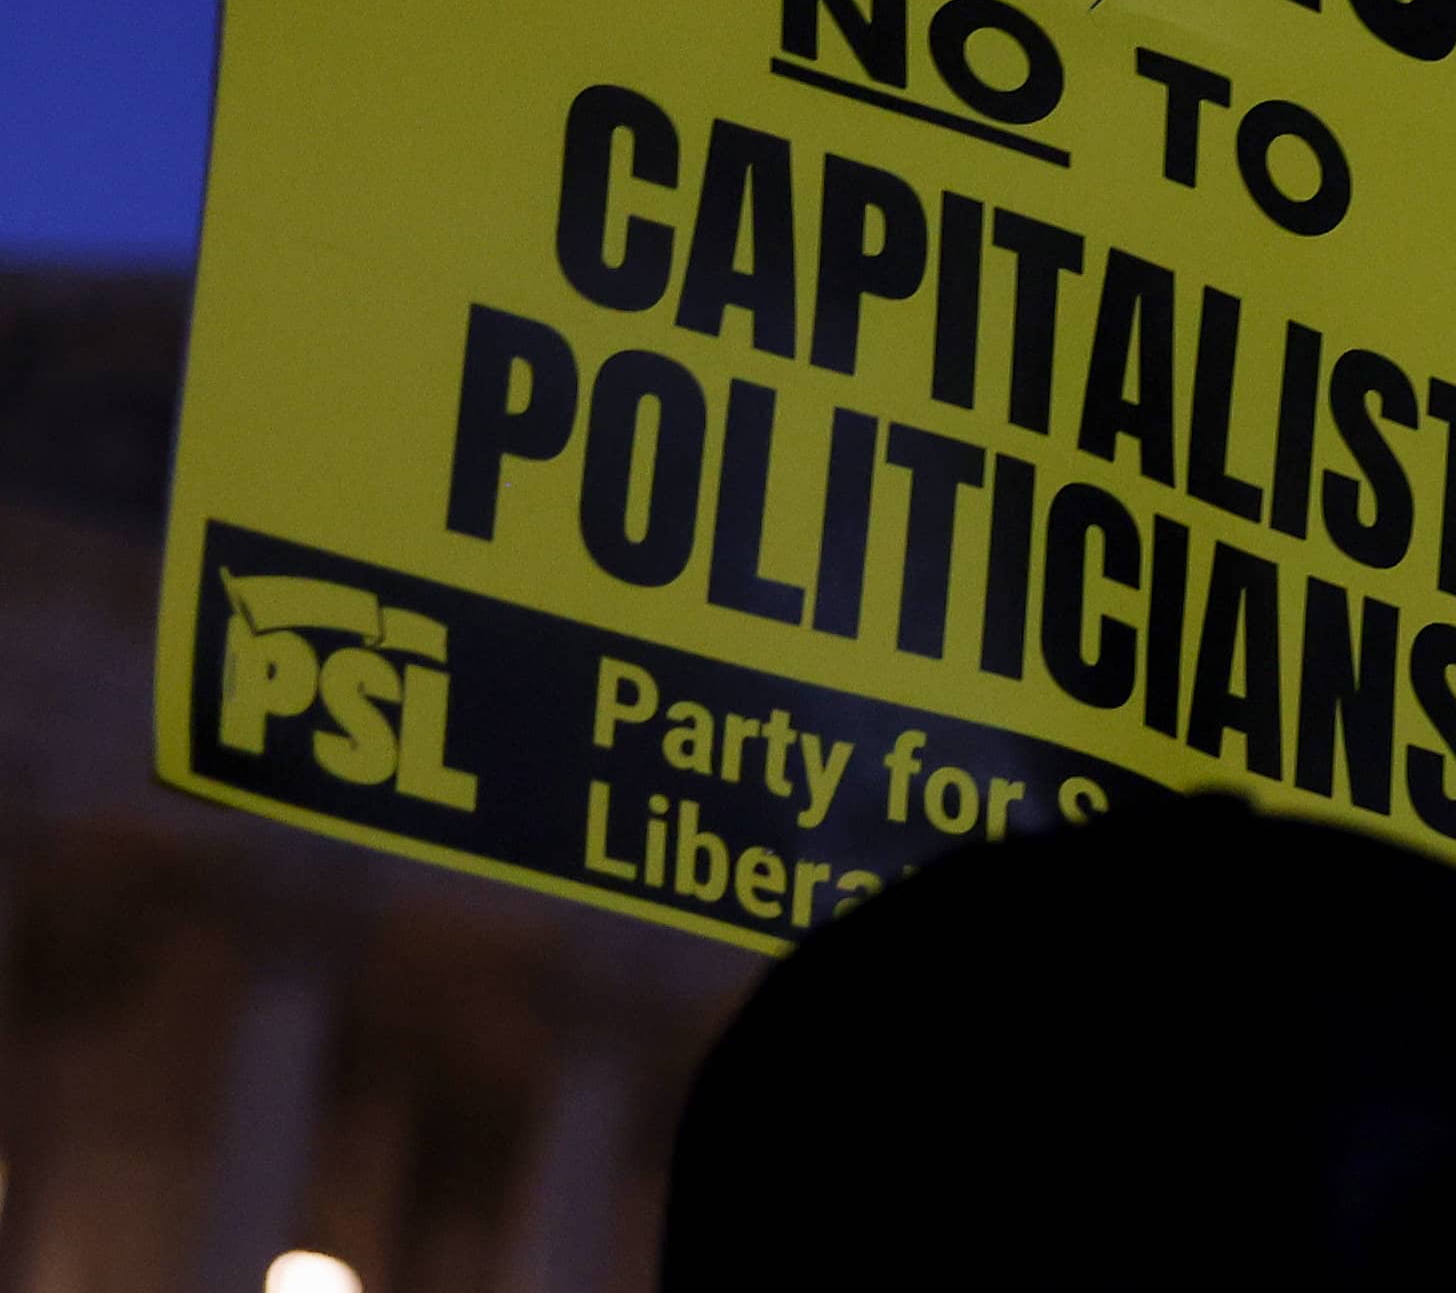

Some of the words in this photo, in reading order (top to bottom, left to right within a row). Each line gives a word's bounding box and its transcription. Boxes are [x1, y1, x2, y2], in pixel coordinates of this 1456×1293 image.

[1135, 47, 1353, 237] TO
[219, 615, 478, 812] PSL
[593, 656, 854, 829] Party
[883, 730, 1026, 845] for
